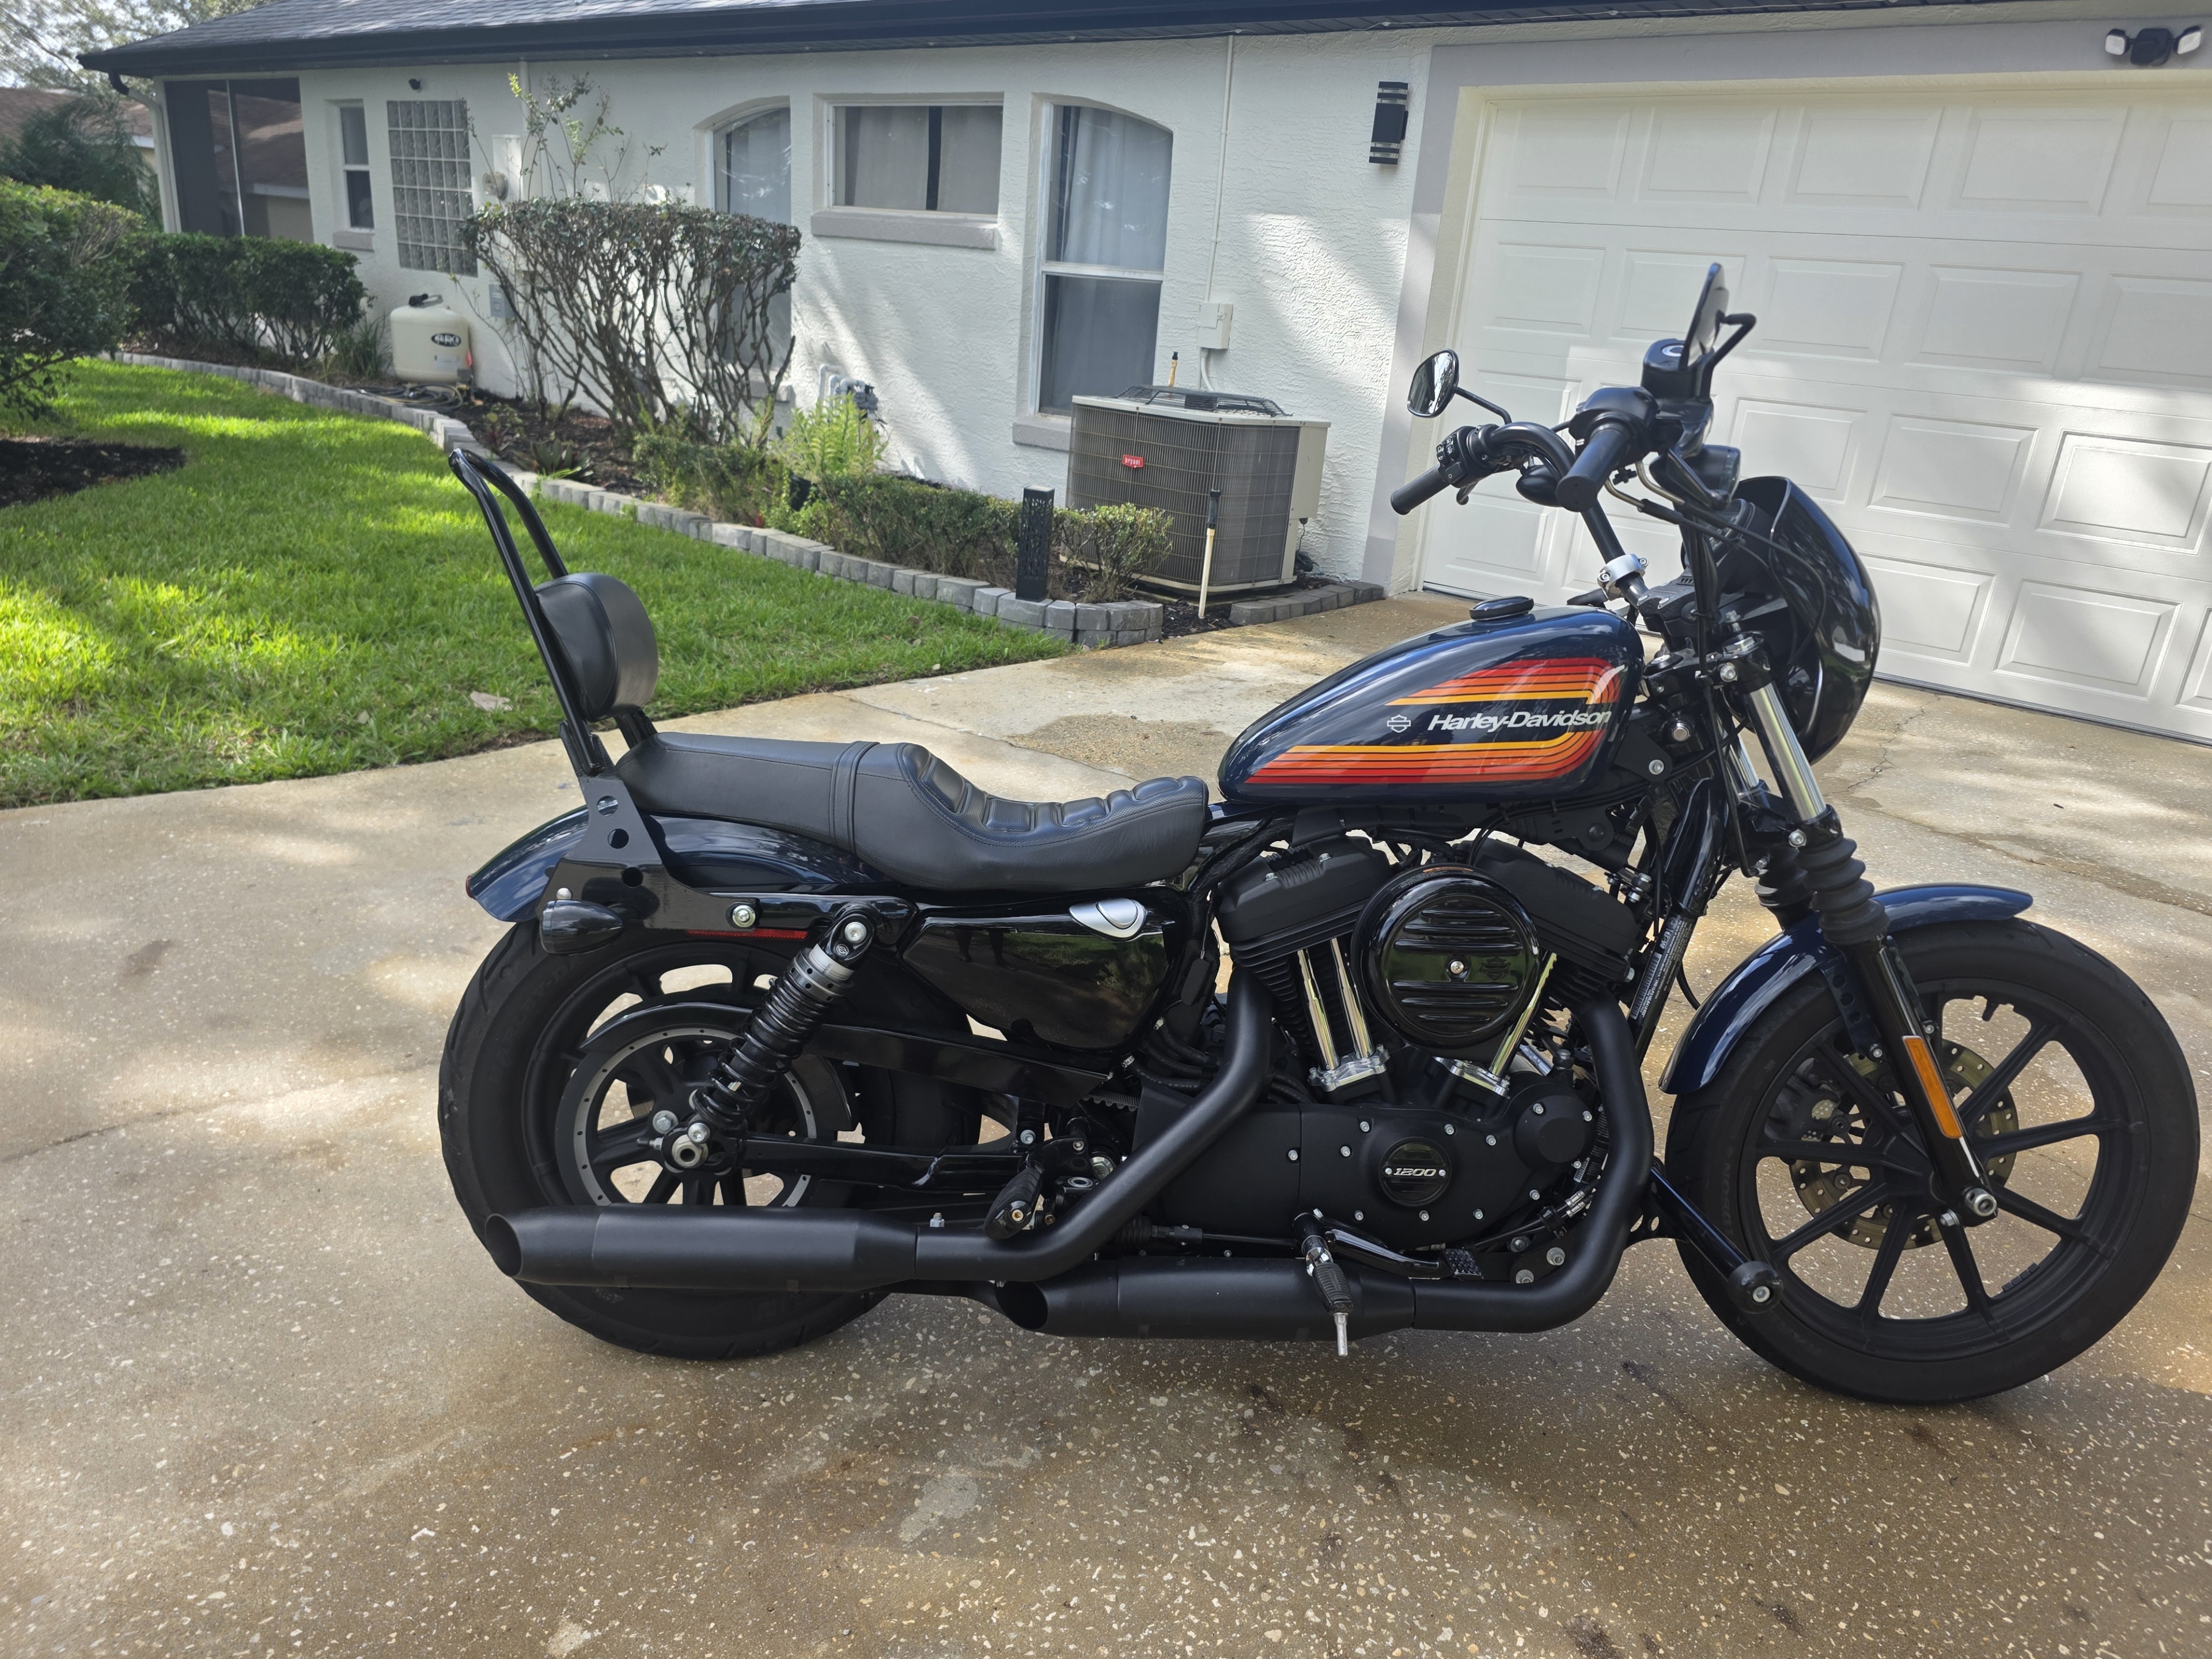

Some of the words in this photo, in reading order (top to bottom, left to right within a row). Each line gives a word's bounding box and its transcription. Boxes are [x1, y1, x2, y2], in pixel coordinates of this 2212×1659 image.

[1124, 457, 1141, 465] bryant
[1427, 710, 1612, 733] Harley-Davidson
[1393, 1168, 1437, 1177] 1200
